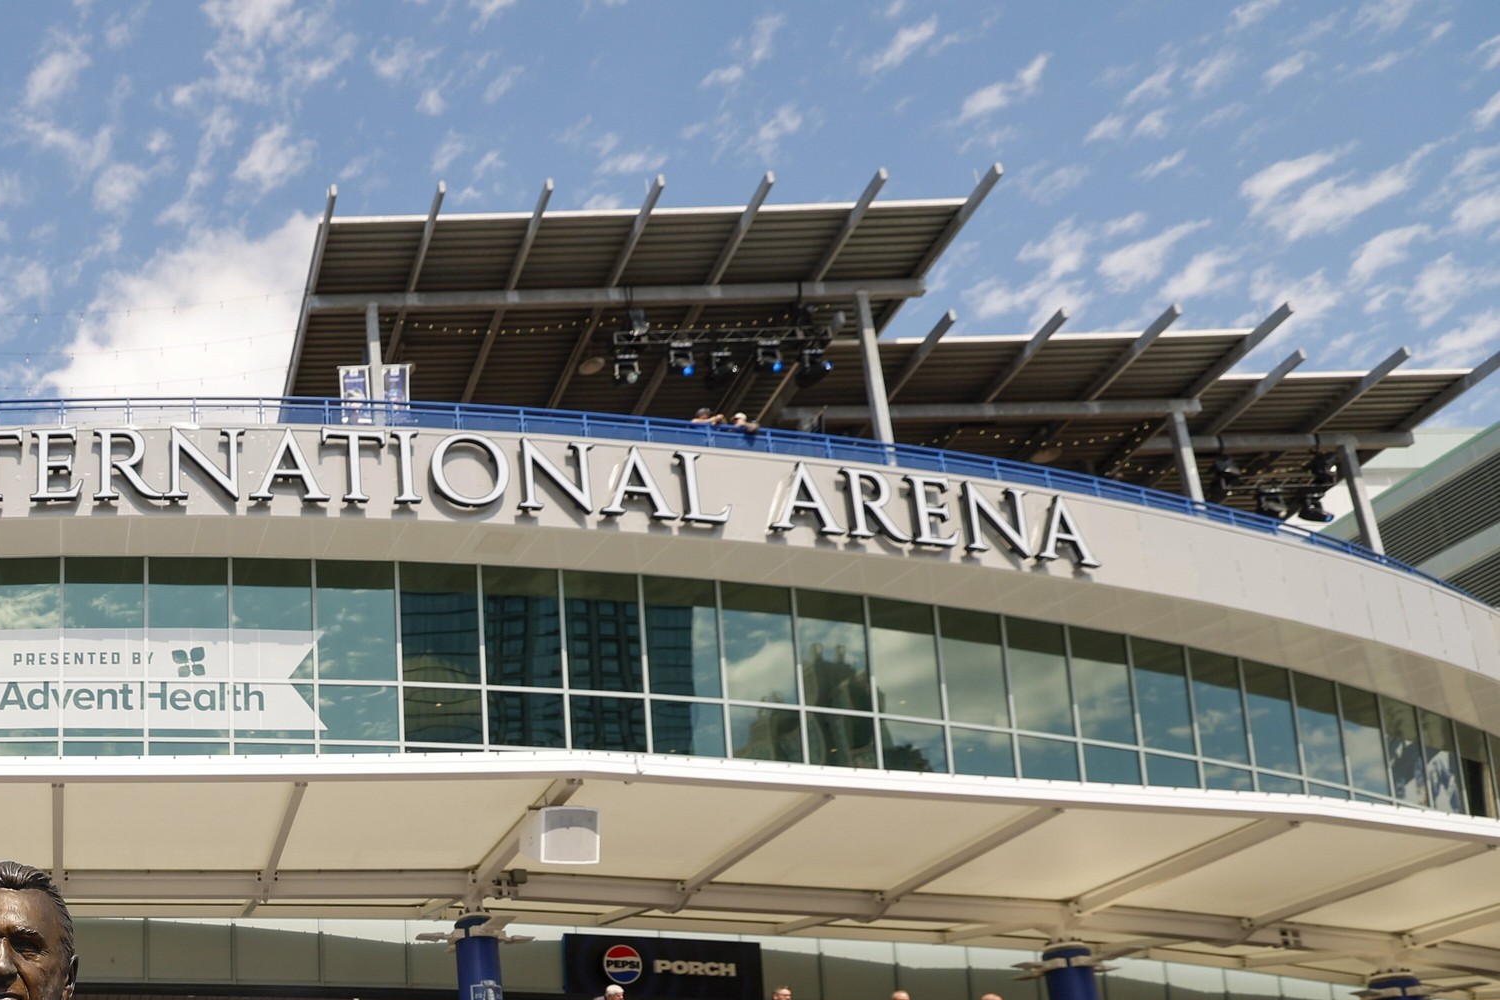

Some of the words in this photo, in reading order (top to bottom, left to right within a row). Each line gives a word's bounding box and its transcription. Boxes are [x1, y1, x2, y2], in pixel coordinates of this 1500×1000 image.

[768, 461, 1101, 569] ARENA
[13, 652, 120, 666] PRESENTED
[132, 652, 155, 666] BY
[606, 959, 641, 970] PEPSI
[654, 959, 737, 977] PORCH
